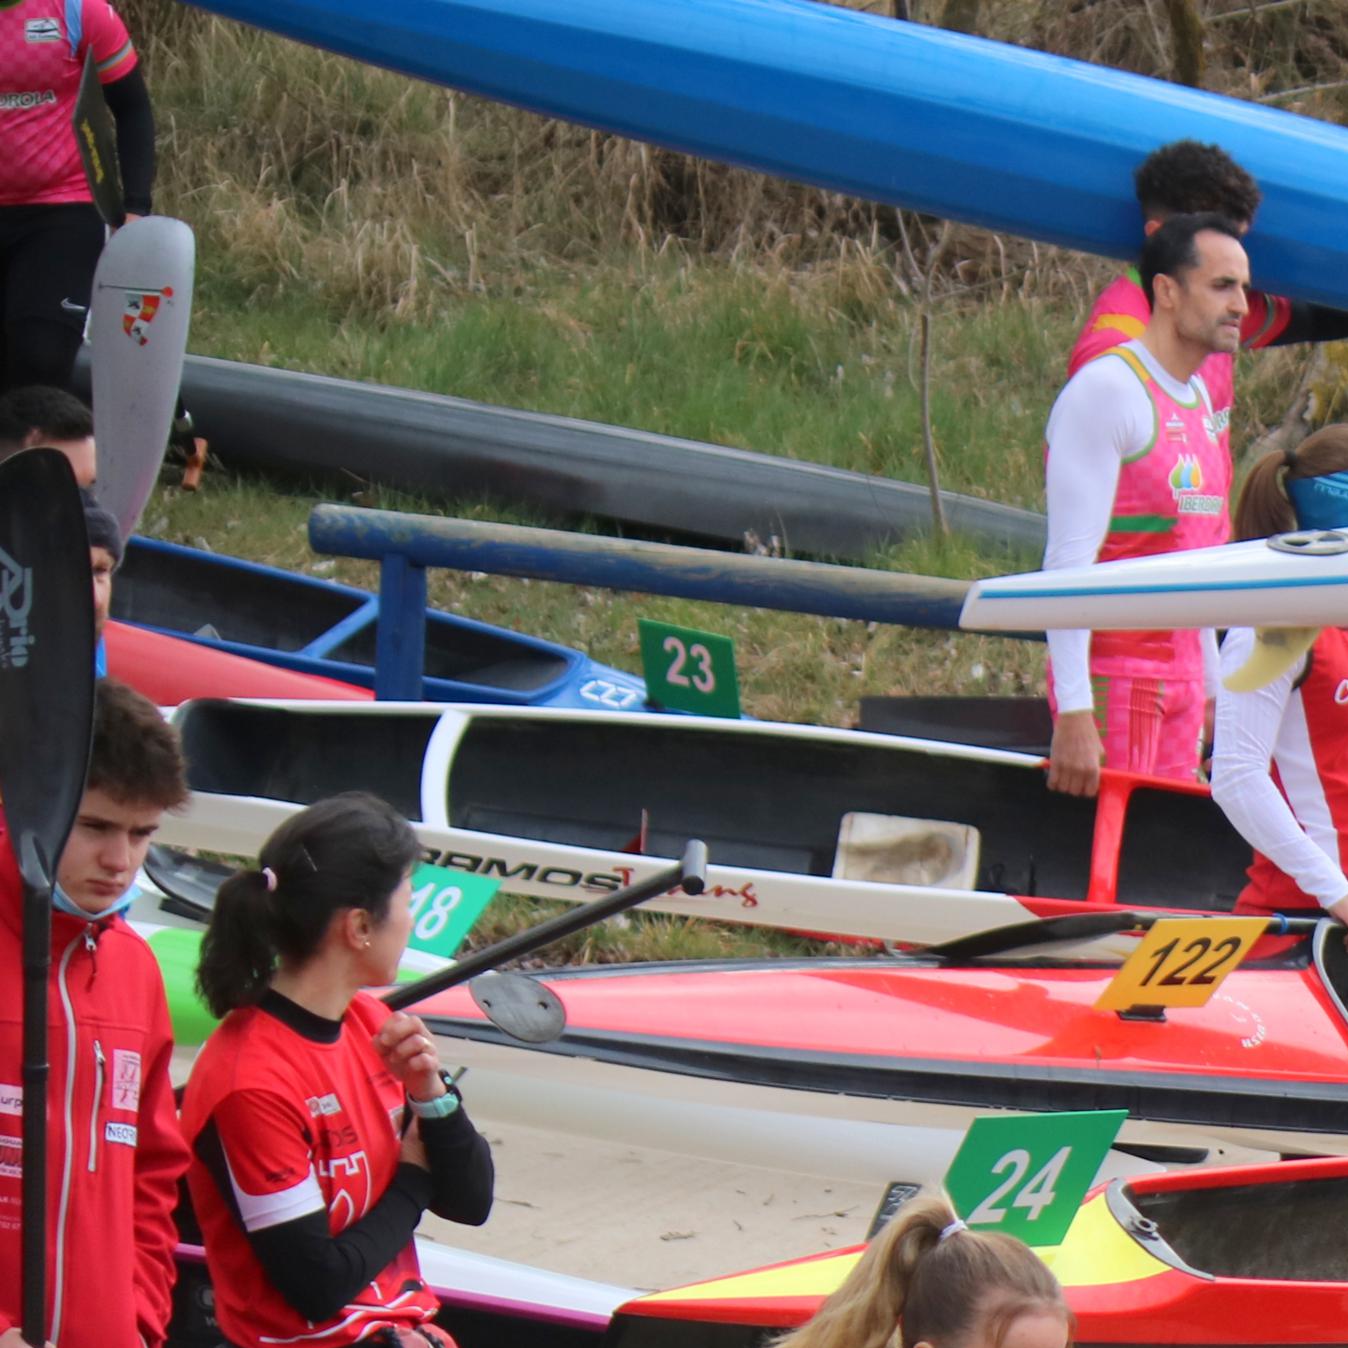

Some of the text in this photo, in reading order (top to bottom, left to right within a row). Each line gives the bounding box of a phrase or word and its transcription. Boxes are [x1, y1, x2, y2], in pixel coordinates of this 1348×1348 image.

[664, 636, 716, 693] 23
[1139, 936, 1242, 986] 122
[965, 1146, 1072, 1224] 24
